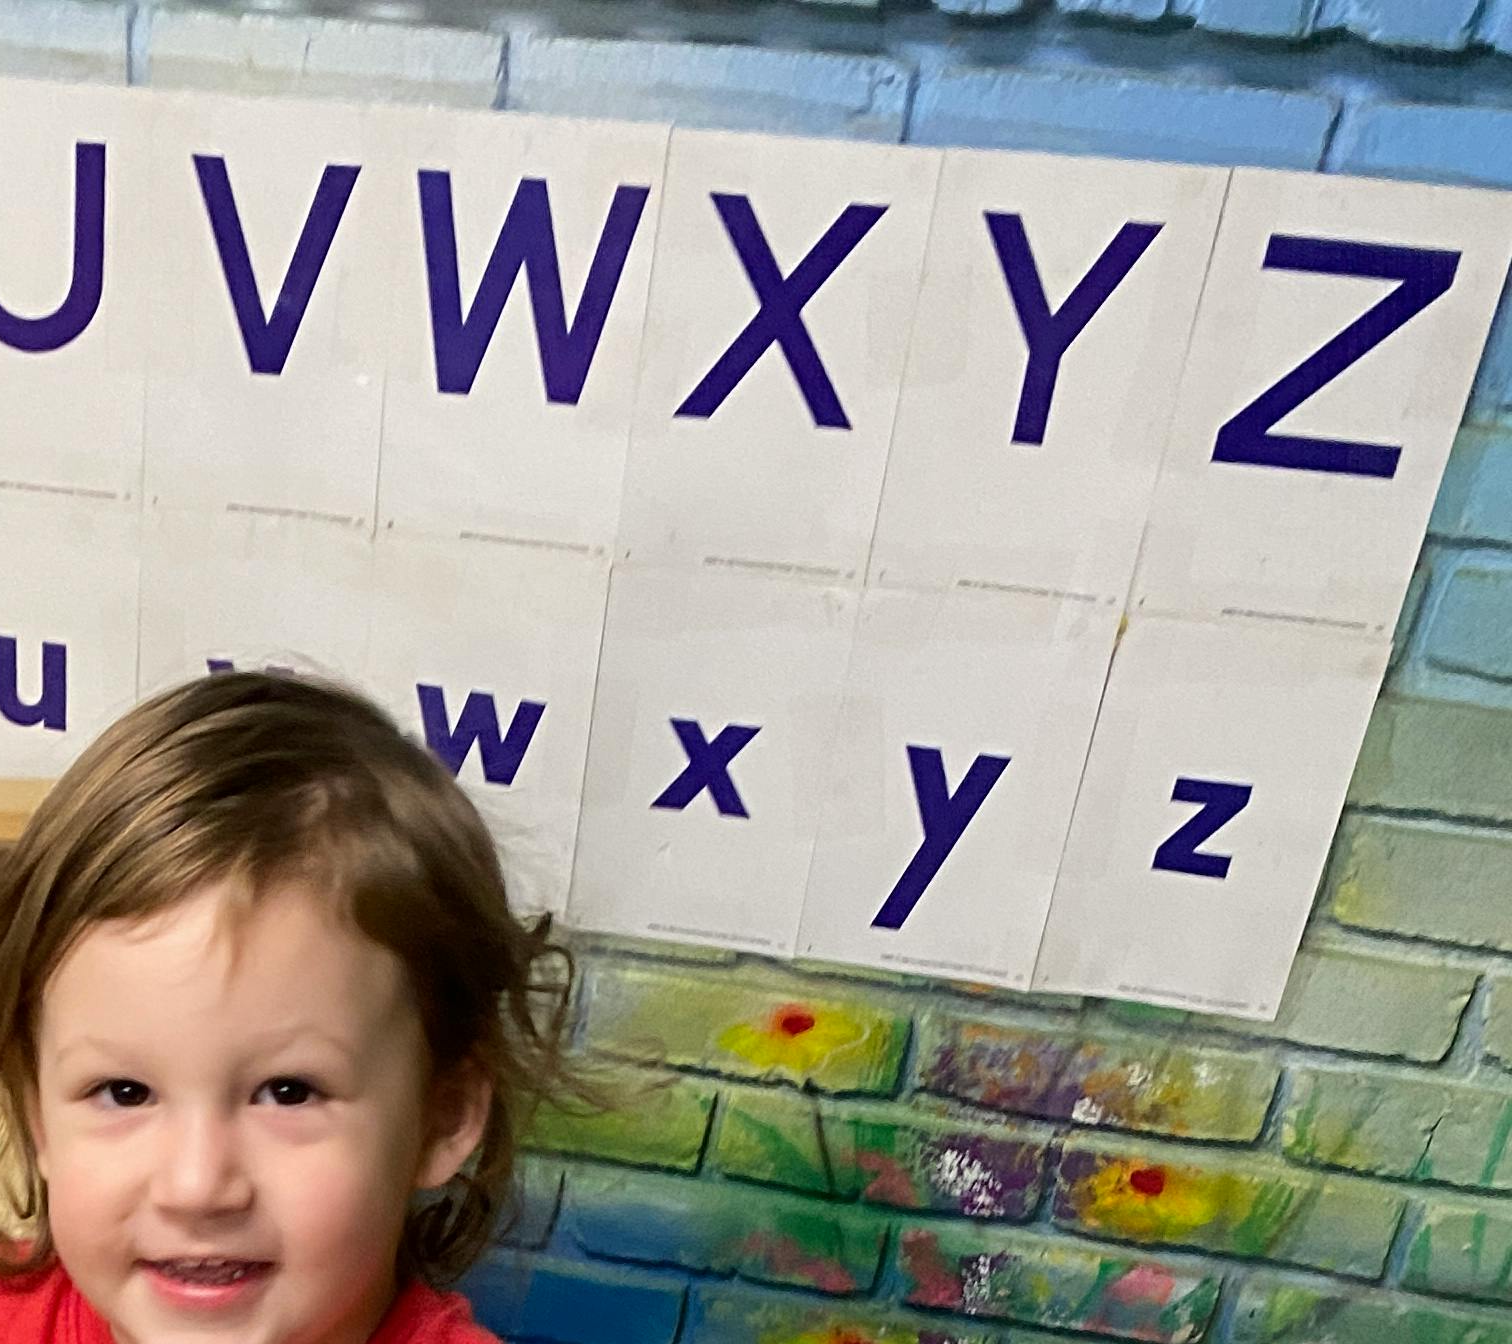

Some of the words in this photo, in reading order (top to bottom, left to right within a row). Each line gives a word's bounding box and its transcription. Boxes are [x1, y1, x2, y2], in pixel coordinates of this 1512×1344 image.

[193, 154, 361, 375] V
[418, 169, 650, 405] W
[673, 192, 889, 429] X
[984, 211, 1165, 446] Y
[1210, 234, 1462, 479] Z
[416, 684, 547, 786] w
[650, 718, 761, 819] x
[870, 744, 1011, 931] y
[1150, 777, 1253, 880] z
